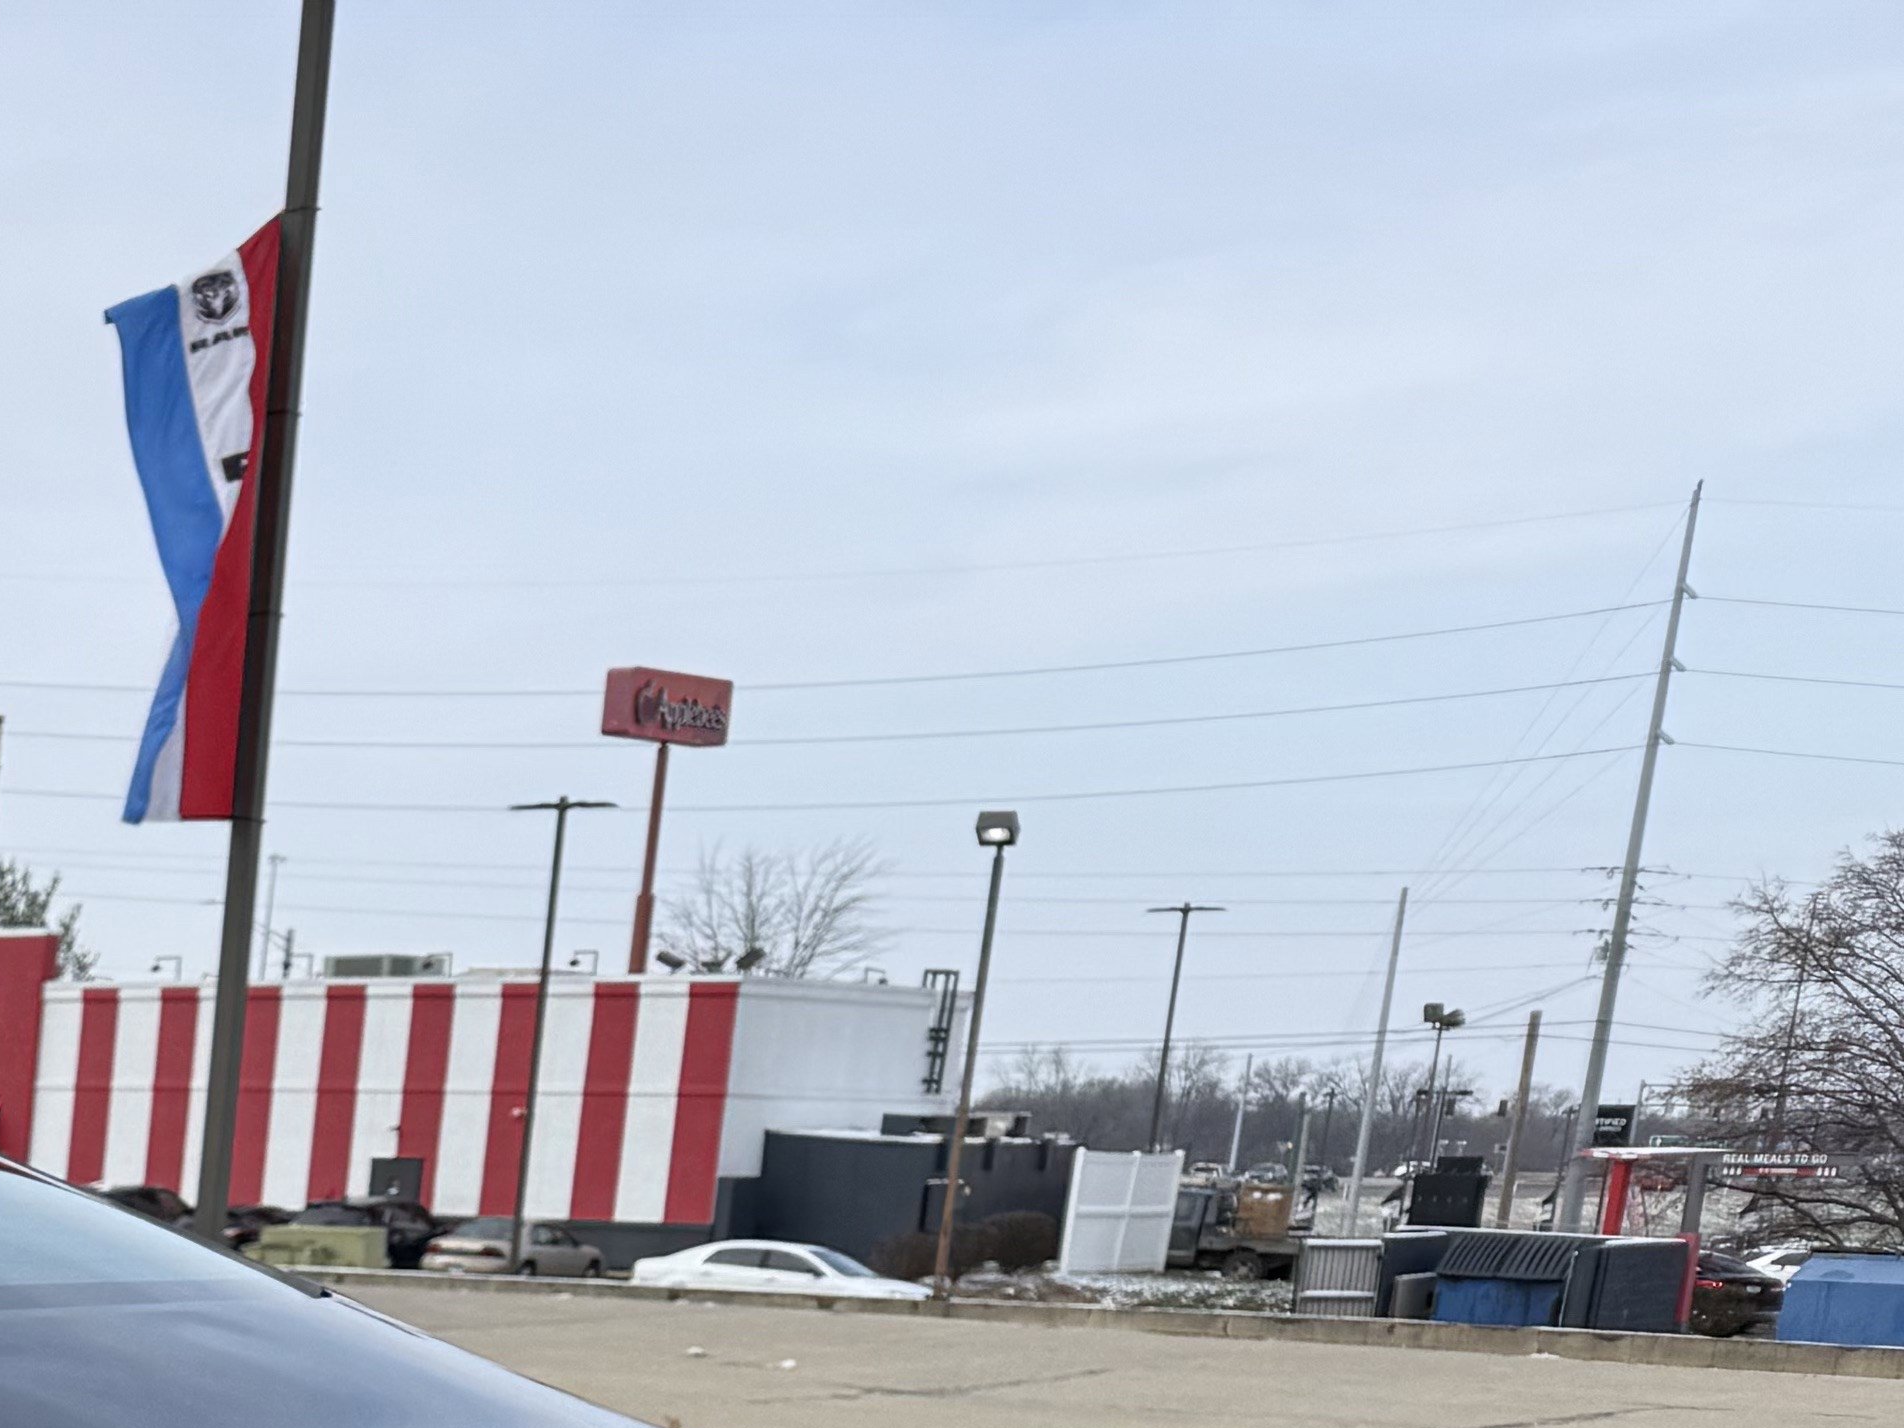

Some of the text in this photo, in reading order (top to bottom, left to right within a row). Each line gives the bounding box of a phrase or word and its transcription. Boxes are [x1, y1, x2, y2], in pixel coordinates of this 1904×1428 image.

[1722, 1153, 1828, 1164] REAL MEALS TO GO
